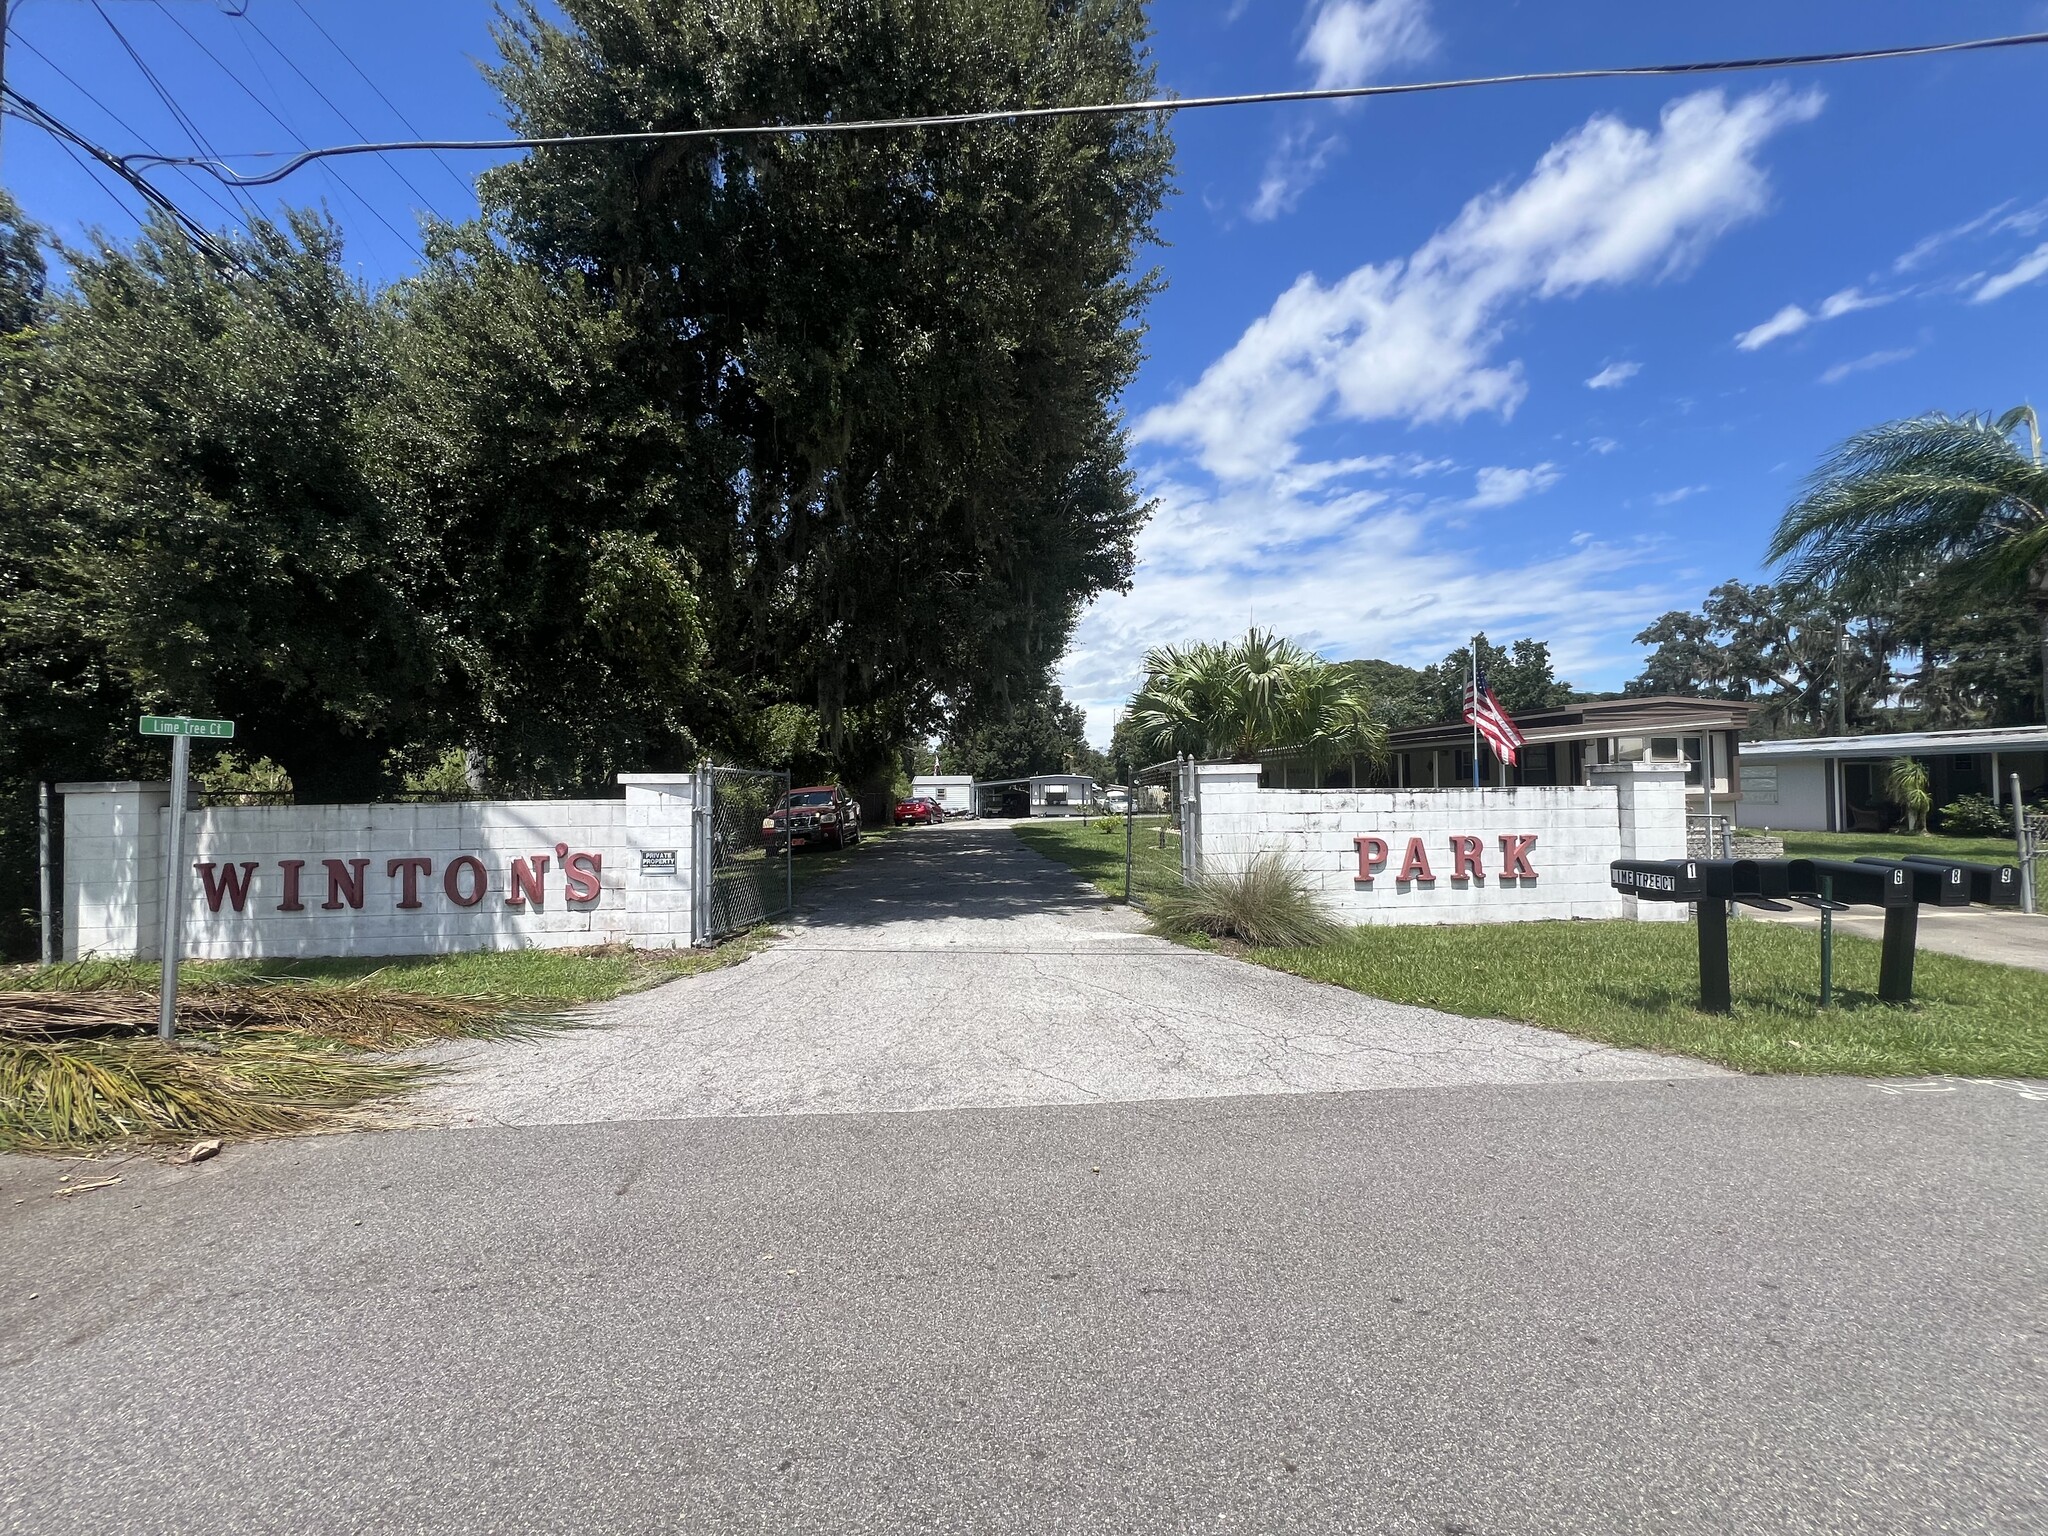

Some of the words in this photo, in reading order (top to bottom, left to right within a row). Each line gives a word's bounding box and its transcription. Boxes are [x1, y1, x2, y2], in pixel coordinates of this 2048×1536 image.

[154, 720, 179, 732] Lime
[183, 721, 206, 734] Tree
[209, 723, 222, 735] Ct
[1353, 833, 1539, 882] PARK
[1611, 869, 1633, 884] LIME
[1689, 864, 1695, 877] 1
[1896, 870, 1902, 883] 6
[1953, 869, 1959, 882] 8
[2003, 868, 2010, 881] 9
[193, 843, 602, 913] WINTON'S
